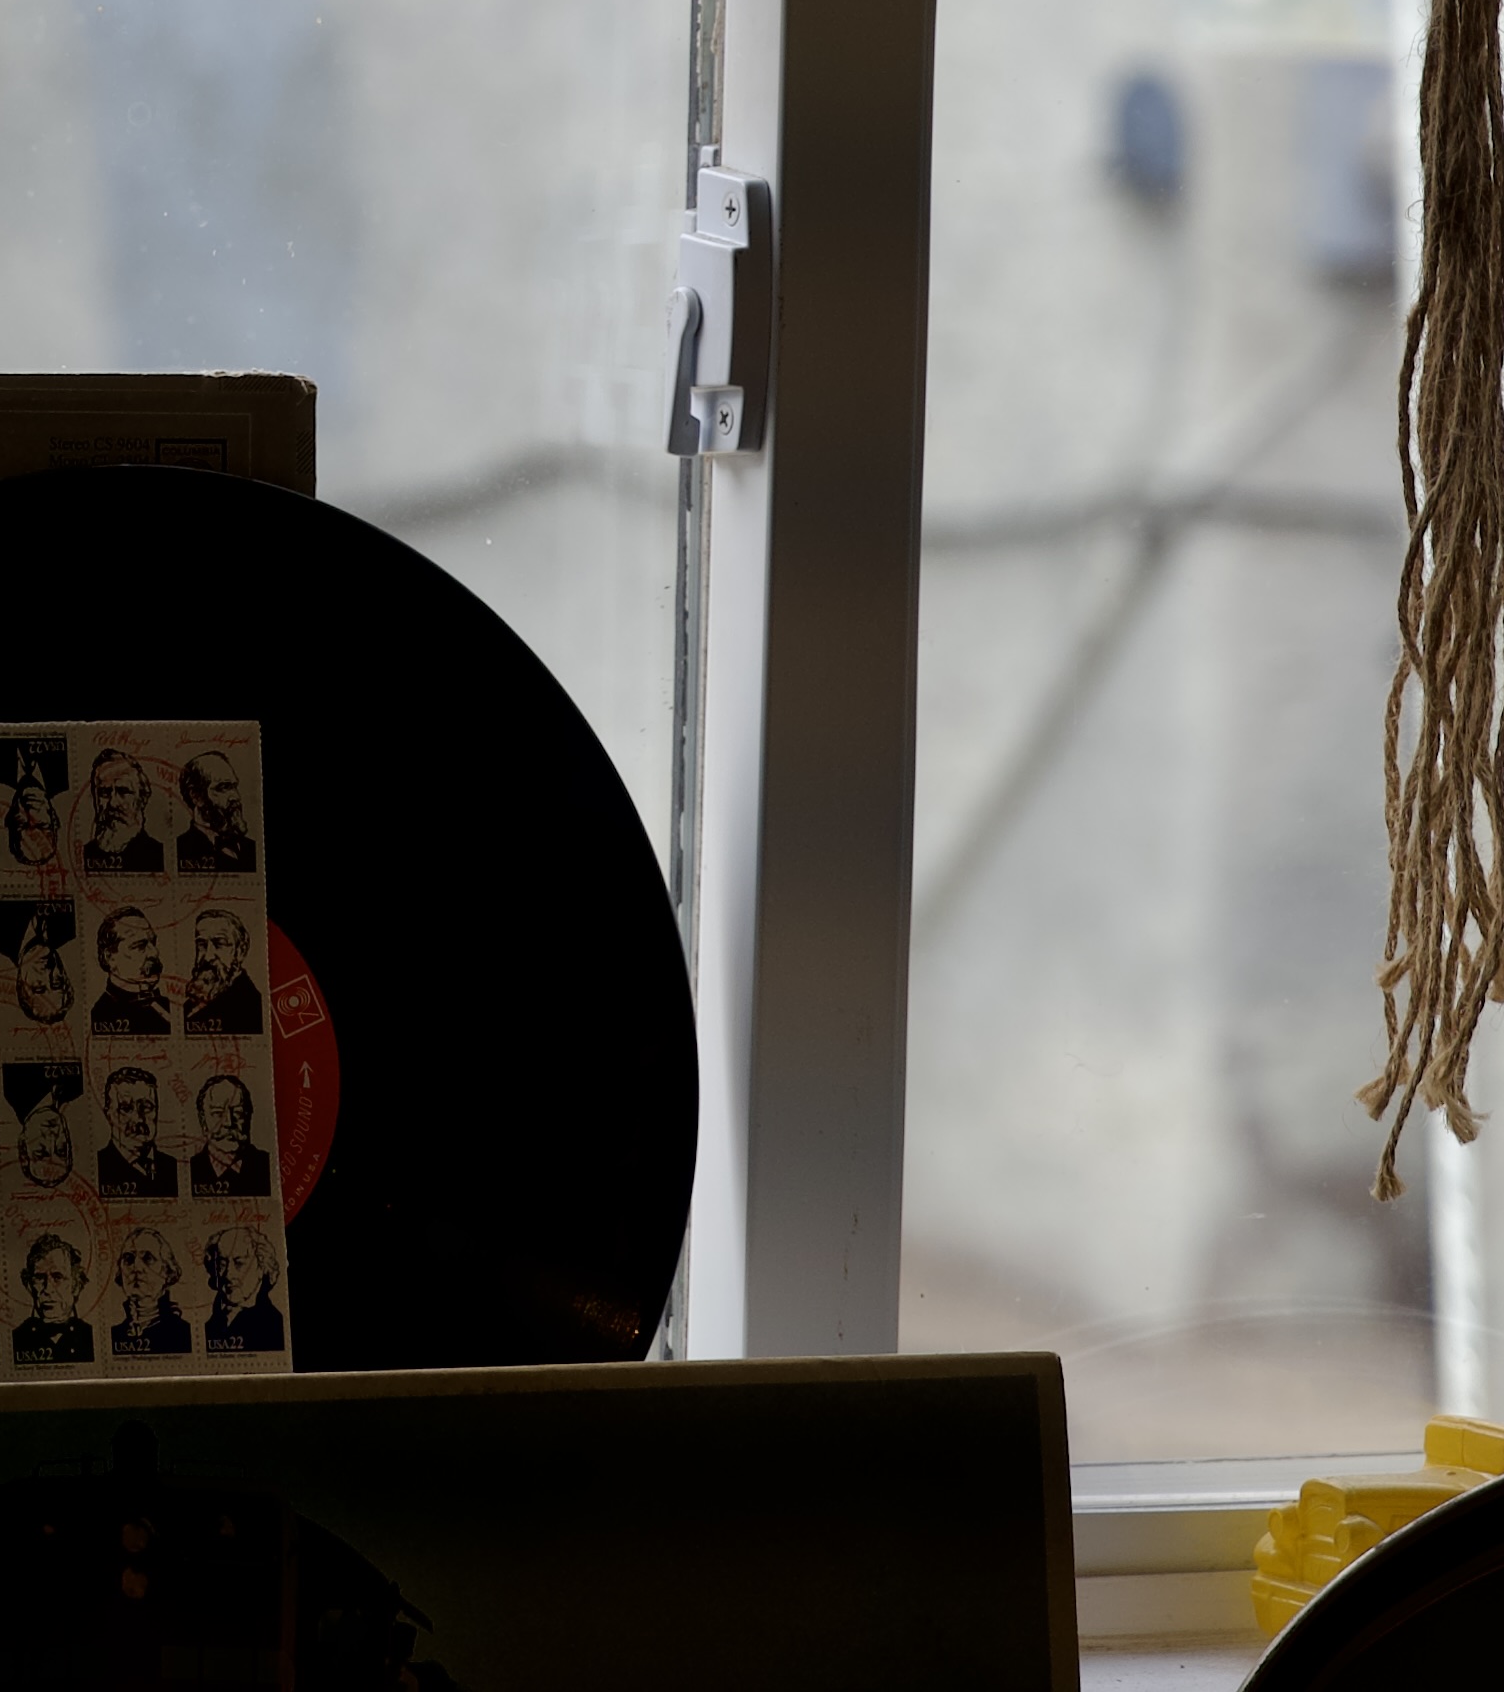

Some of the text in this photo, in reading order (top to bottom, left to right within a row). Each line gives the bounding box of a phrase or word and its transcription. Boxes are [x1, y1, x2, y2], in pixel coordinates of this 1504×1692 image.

[49, 437, 150, 450] Stereo CS 9604
[290, 1096, 313, 1154] SOUND
